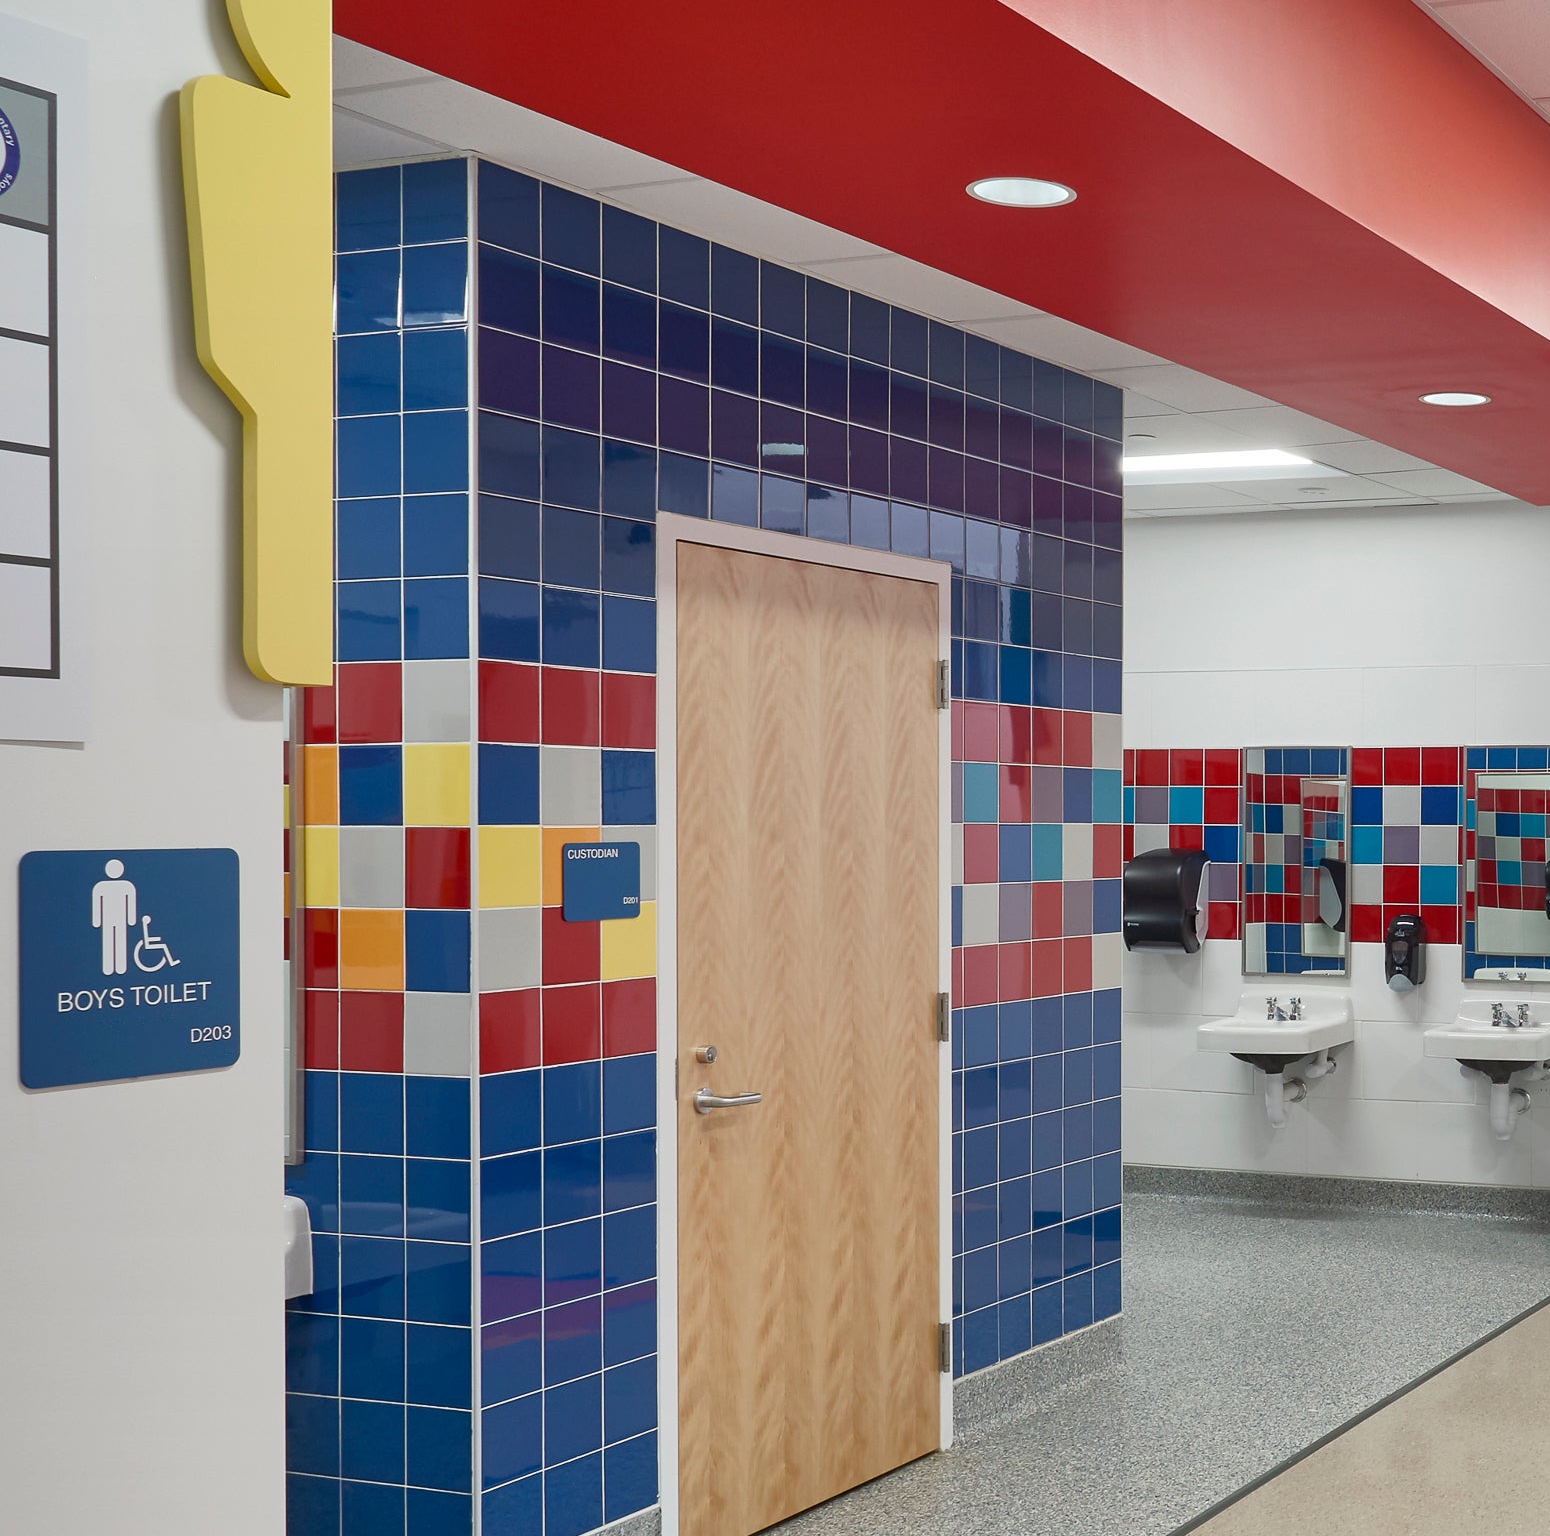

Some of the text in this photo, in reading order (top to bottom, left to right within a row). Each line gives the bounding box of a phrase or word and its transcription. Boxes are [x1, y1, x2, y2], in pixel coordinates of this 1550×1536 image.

[0, 173, 13, 191] oys
[567, 848, 619, 860] CUSTODIAN
[57, 981, 212, 1013] BOYS TOILET
[190, 1025, 232, 1043] D203
